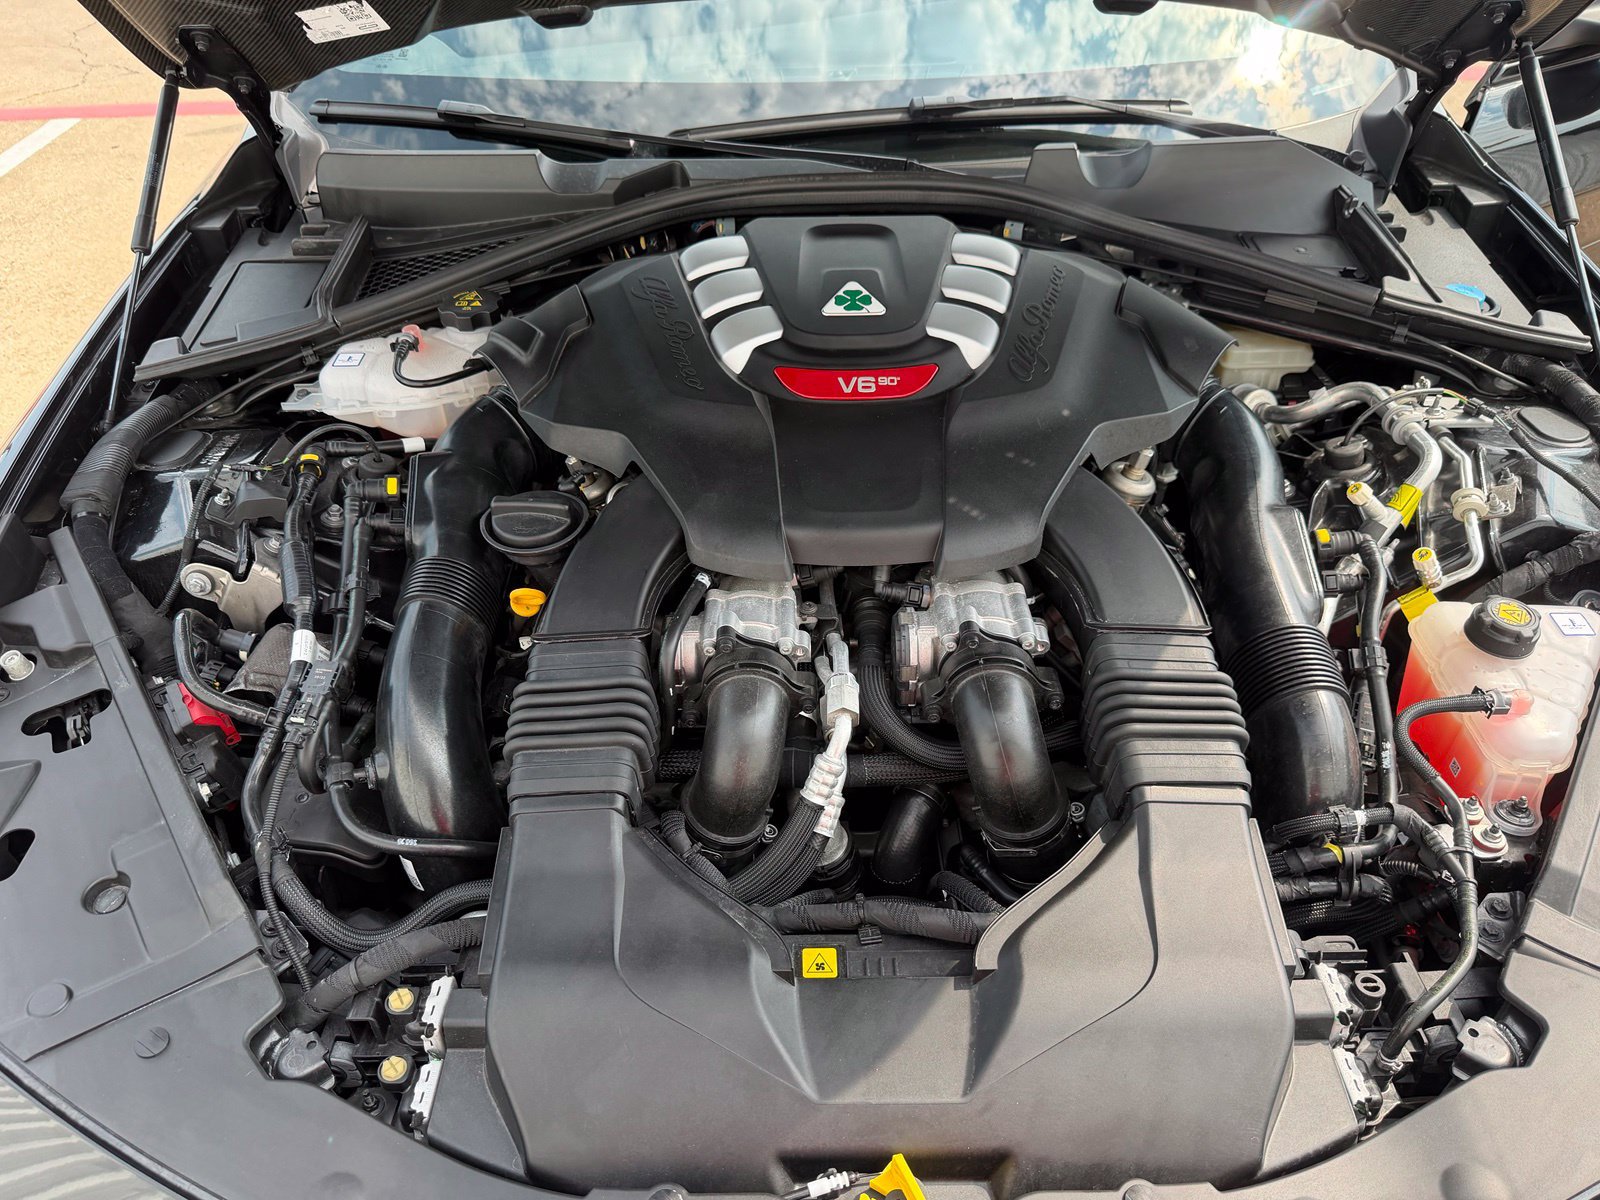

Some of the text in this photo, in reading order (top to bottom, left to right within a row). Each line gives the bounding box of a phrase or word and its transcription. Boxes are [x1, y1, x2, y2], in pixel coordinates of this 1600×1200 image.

[631, 277, 705, 390] Alfa Romeo
[1008, 264, 1066, 382] Alfa Romeo
